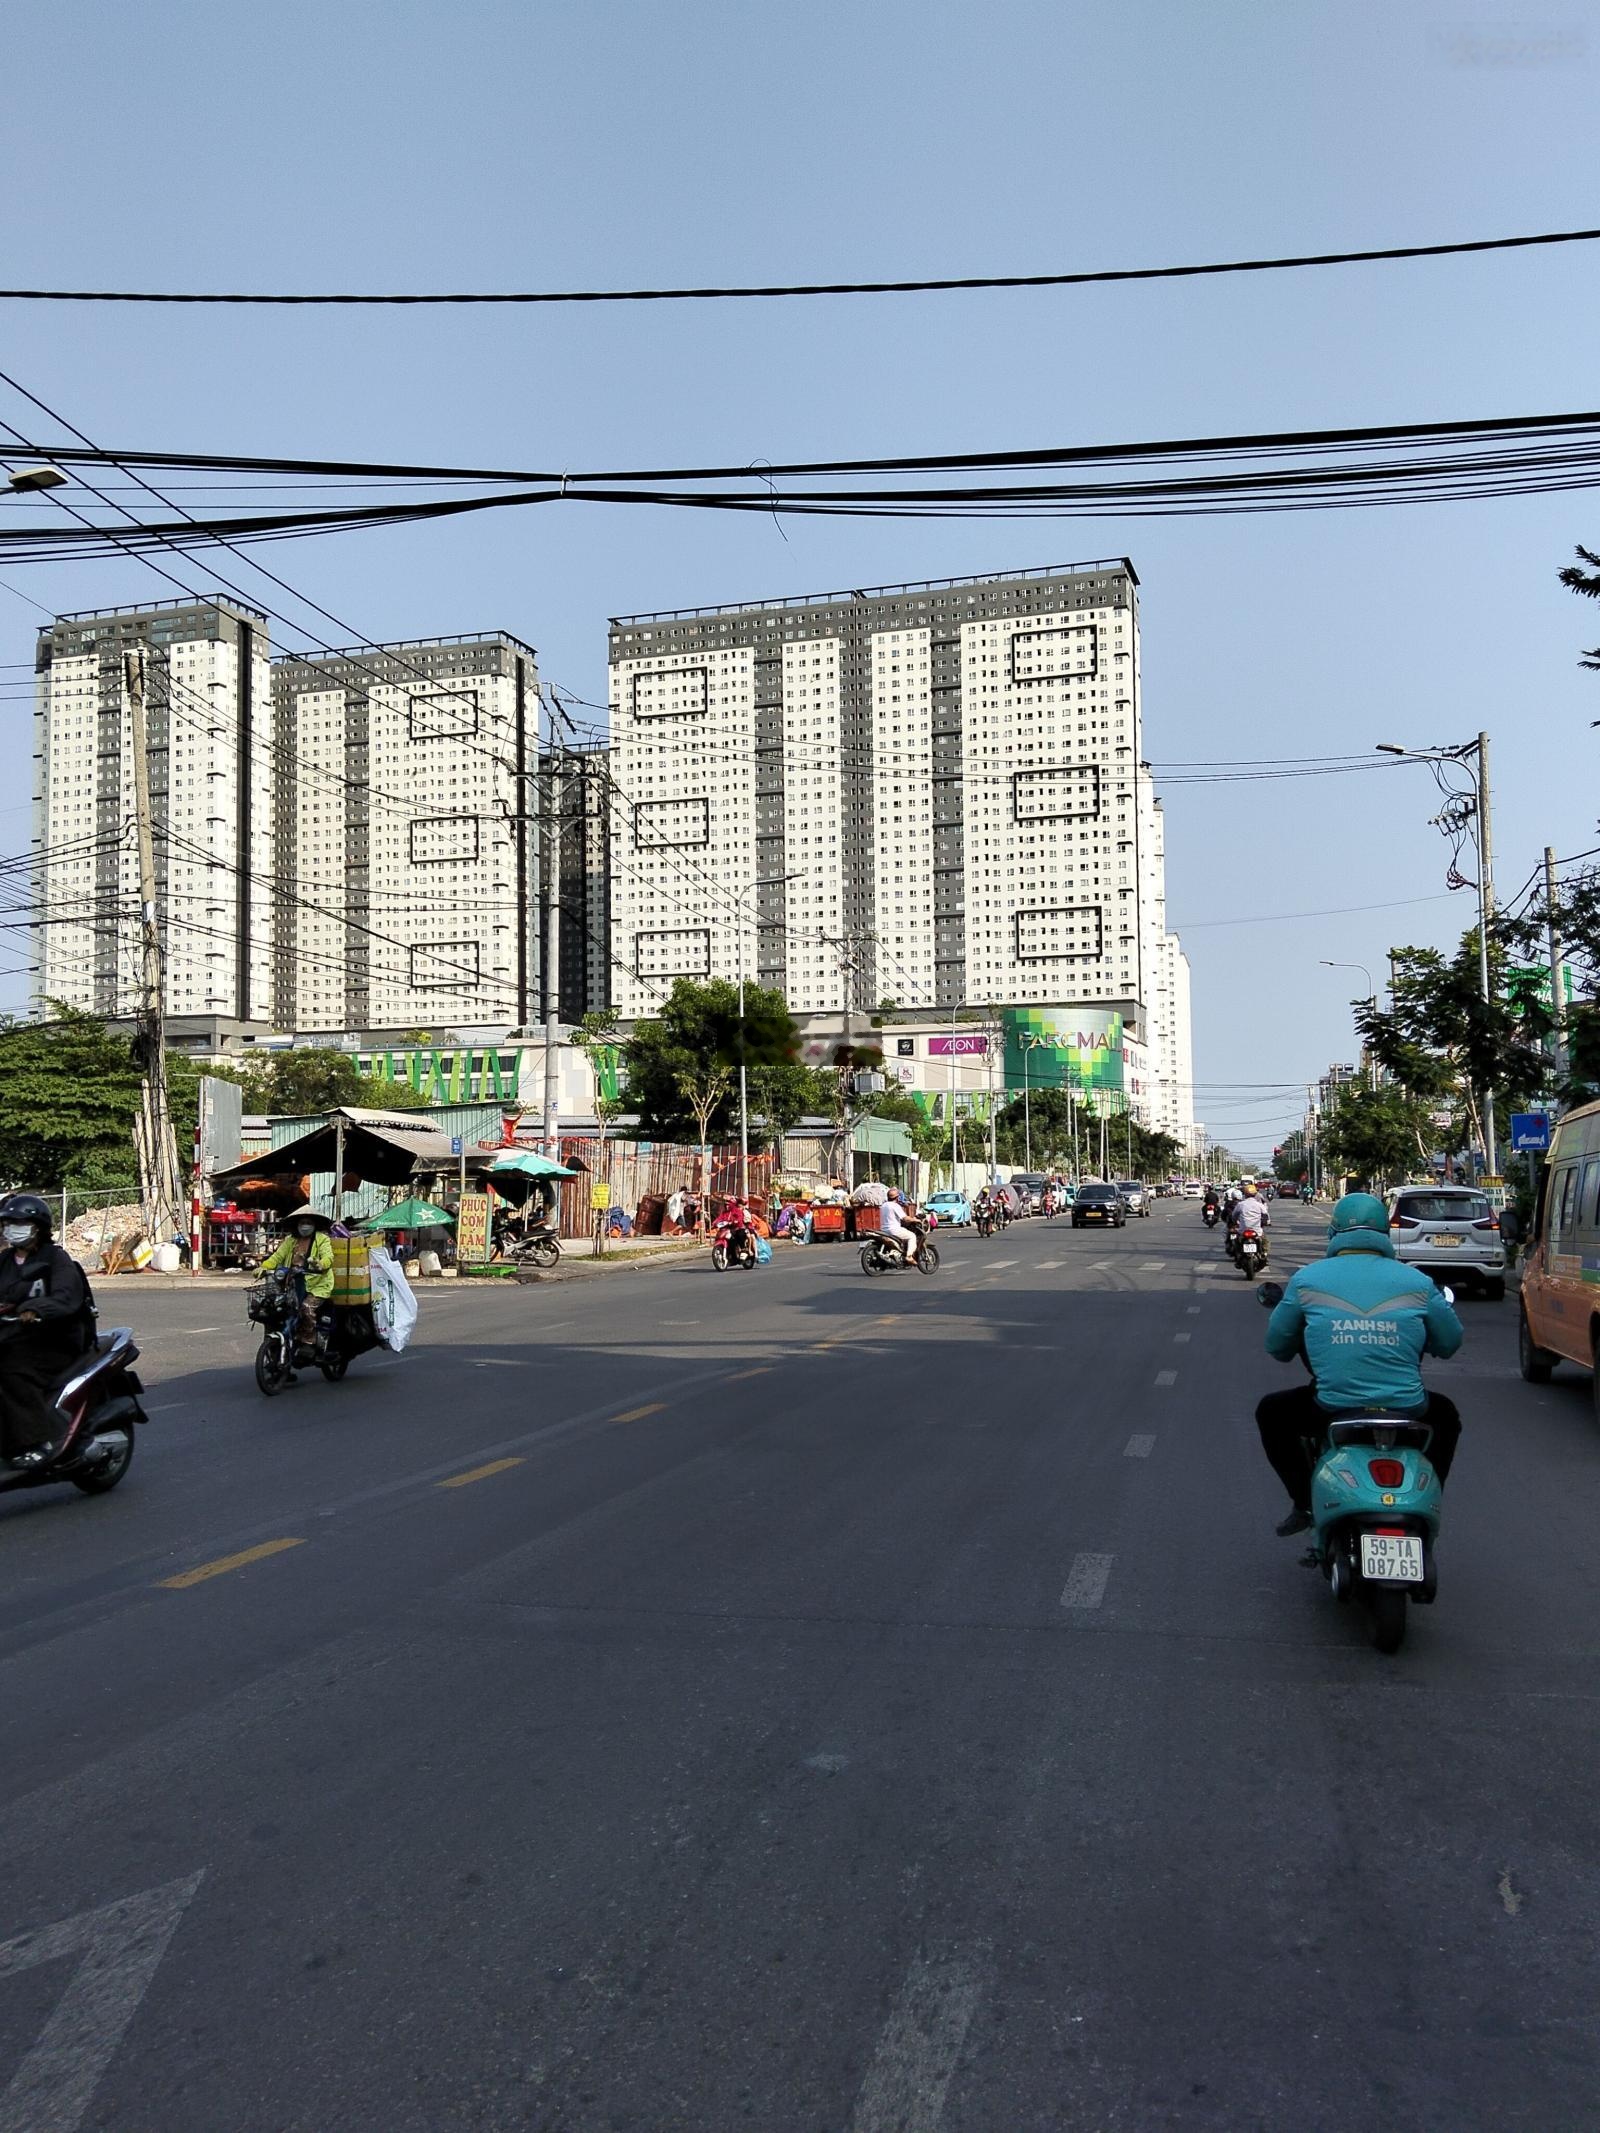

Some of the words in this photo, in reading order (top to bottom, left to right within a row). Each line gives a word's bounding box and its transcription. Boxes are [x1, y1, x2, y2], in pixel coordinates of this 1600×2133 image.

[461, 1213, 485, 1227] CƠM
[1331, 1332, 1354, 1344] xin
[1359, 1332, 1400, 1346] chào!
[1370, 1539, 1413, 1558] 59-TA
[1367, 1558, 1418, 1577] 087.65
